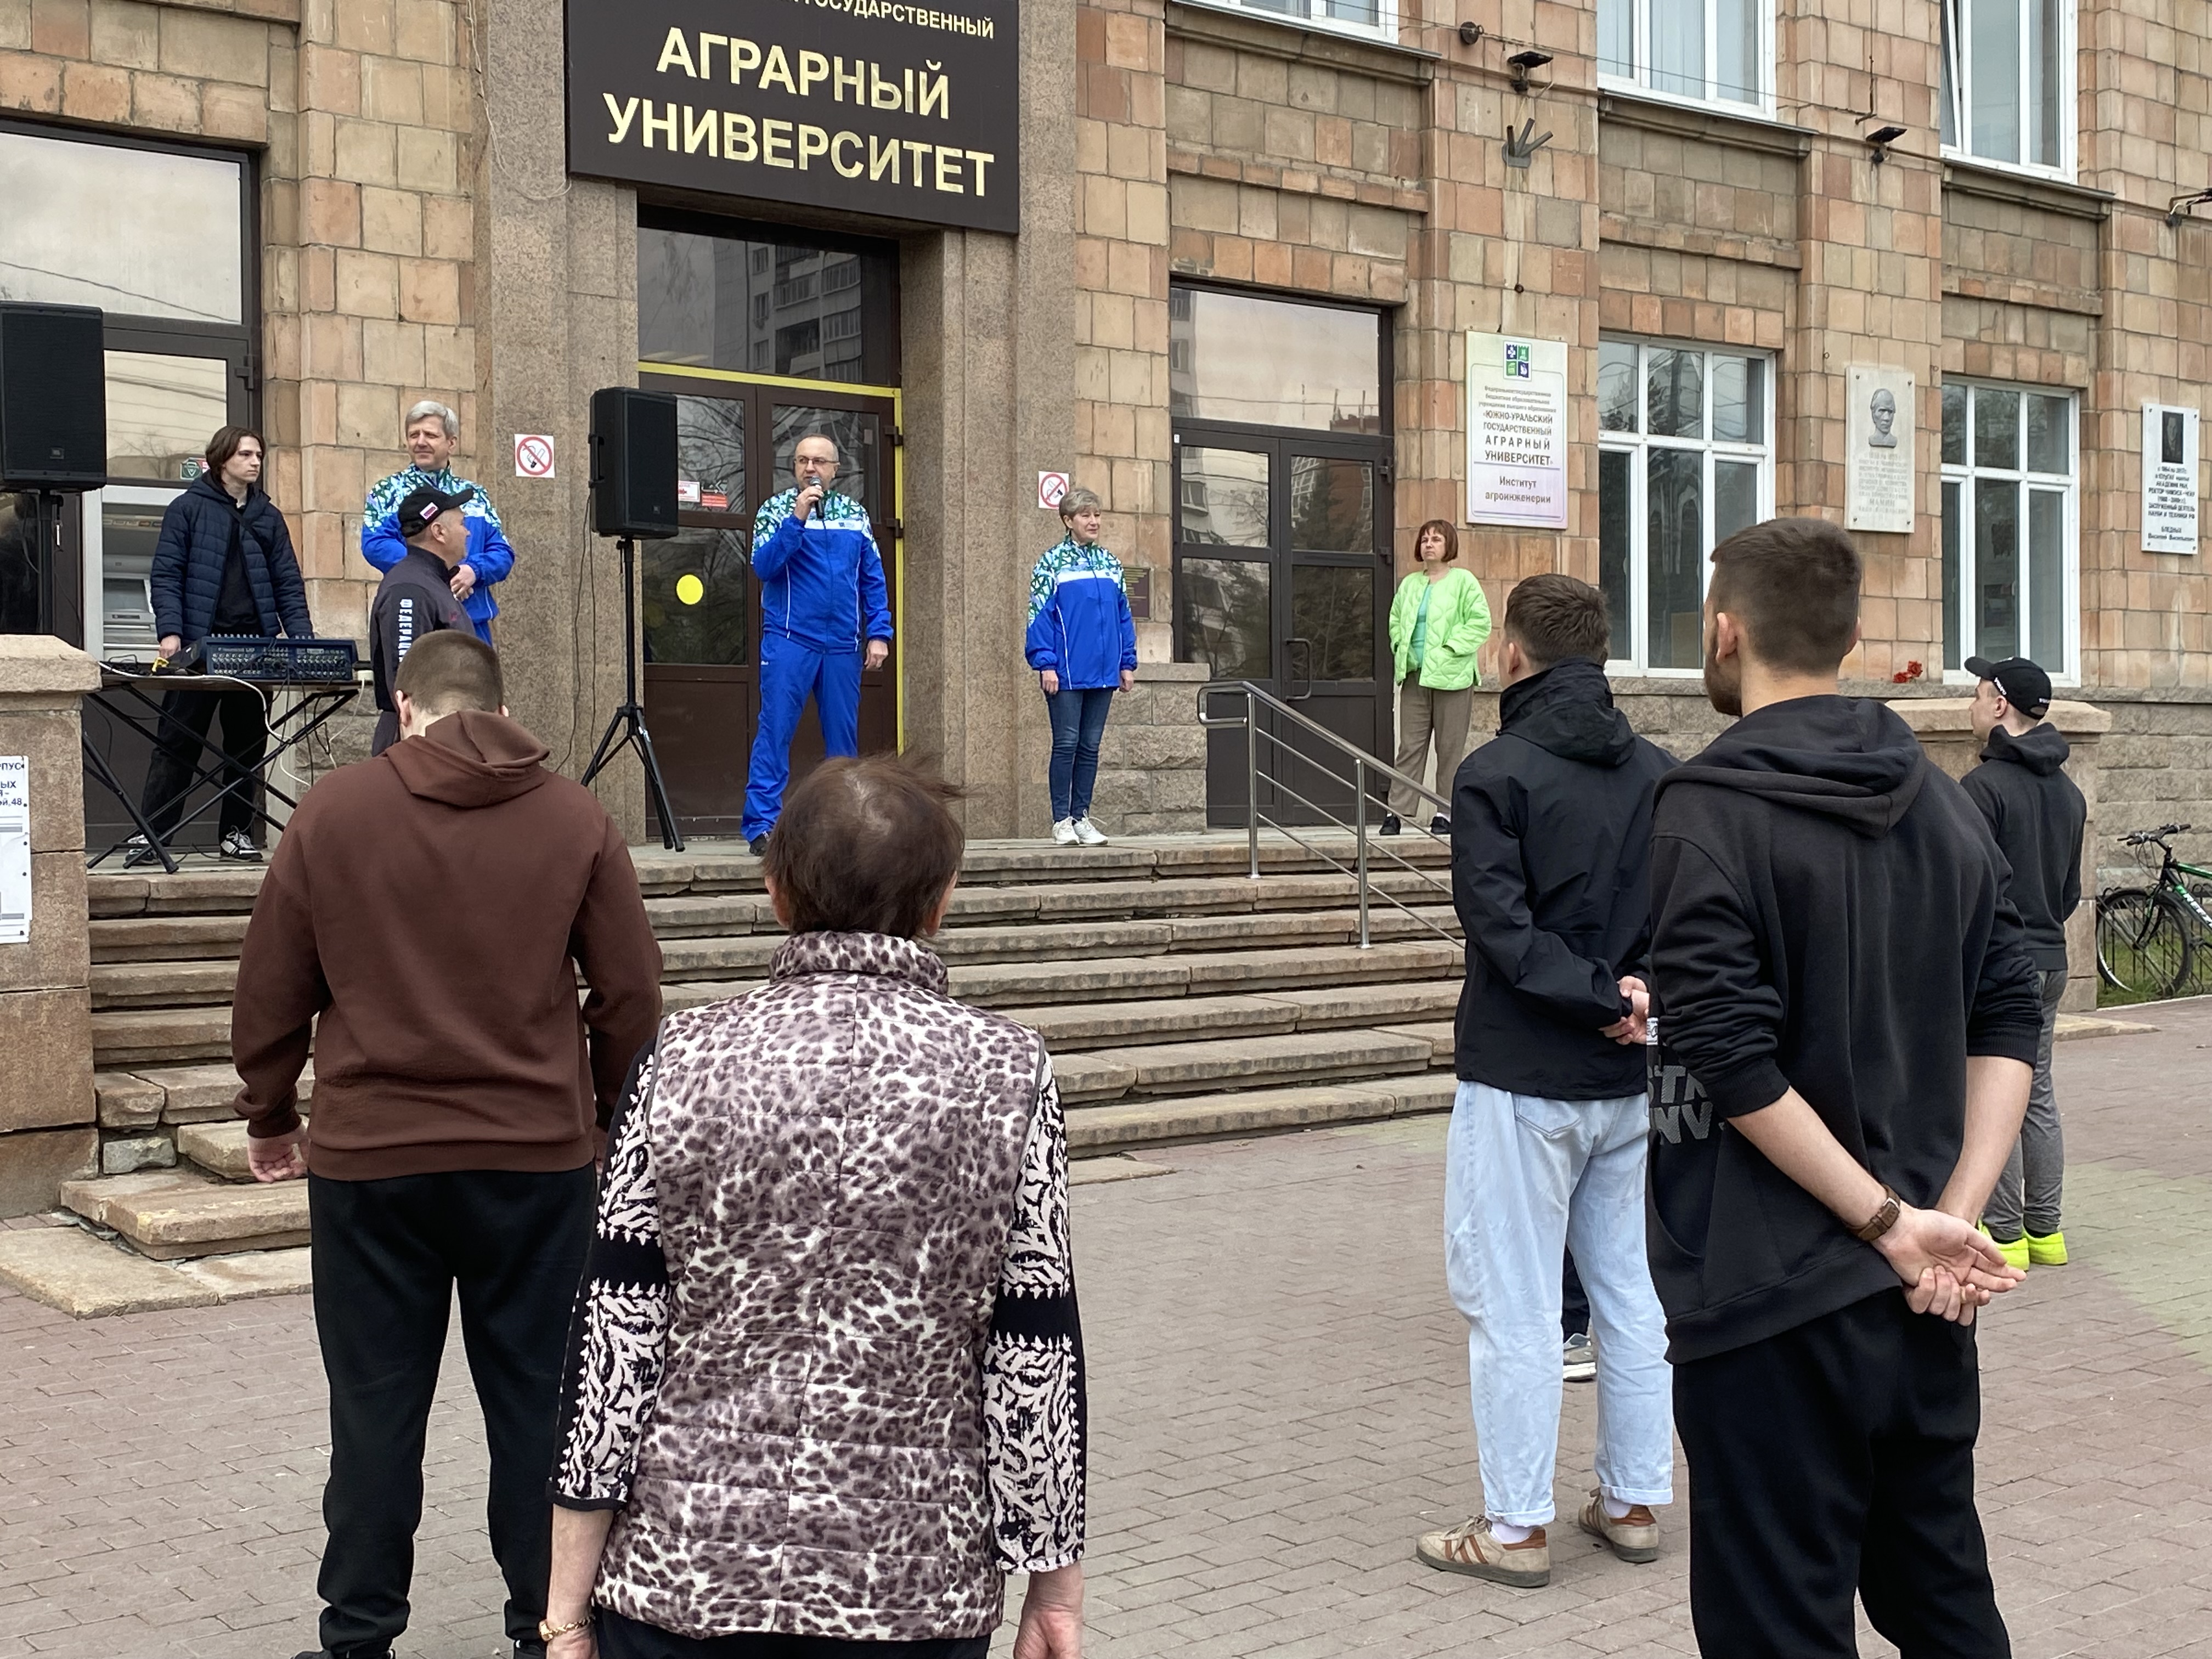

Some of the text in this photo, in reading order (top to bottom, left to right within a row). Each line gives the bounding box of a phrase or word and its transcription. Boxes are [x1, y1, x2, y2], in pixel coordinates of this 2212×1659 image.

[656, 26, 950, 120] АГРАРНЫЙ
[602, 92, 995, 198] УНИВЕРСИТЕТ
[1483, 422, 1551, 436] ГОСУДАРСТВЕННЫЙ
[1485, 435, 1550, 450] АГРАРНЫЙ
[1499, 476, 1537, 489] Институт
[1485, 492, 1551, 504] агроинженерии
[398, 599, 413, 662] ФЕДЕРАЦИ
